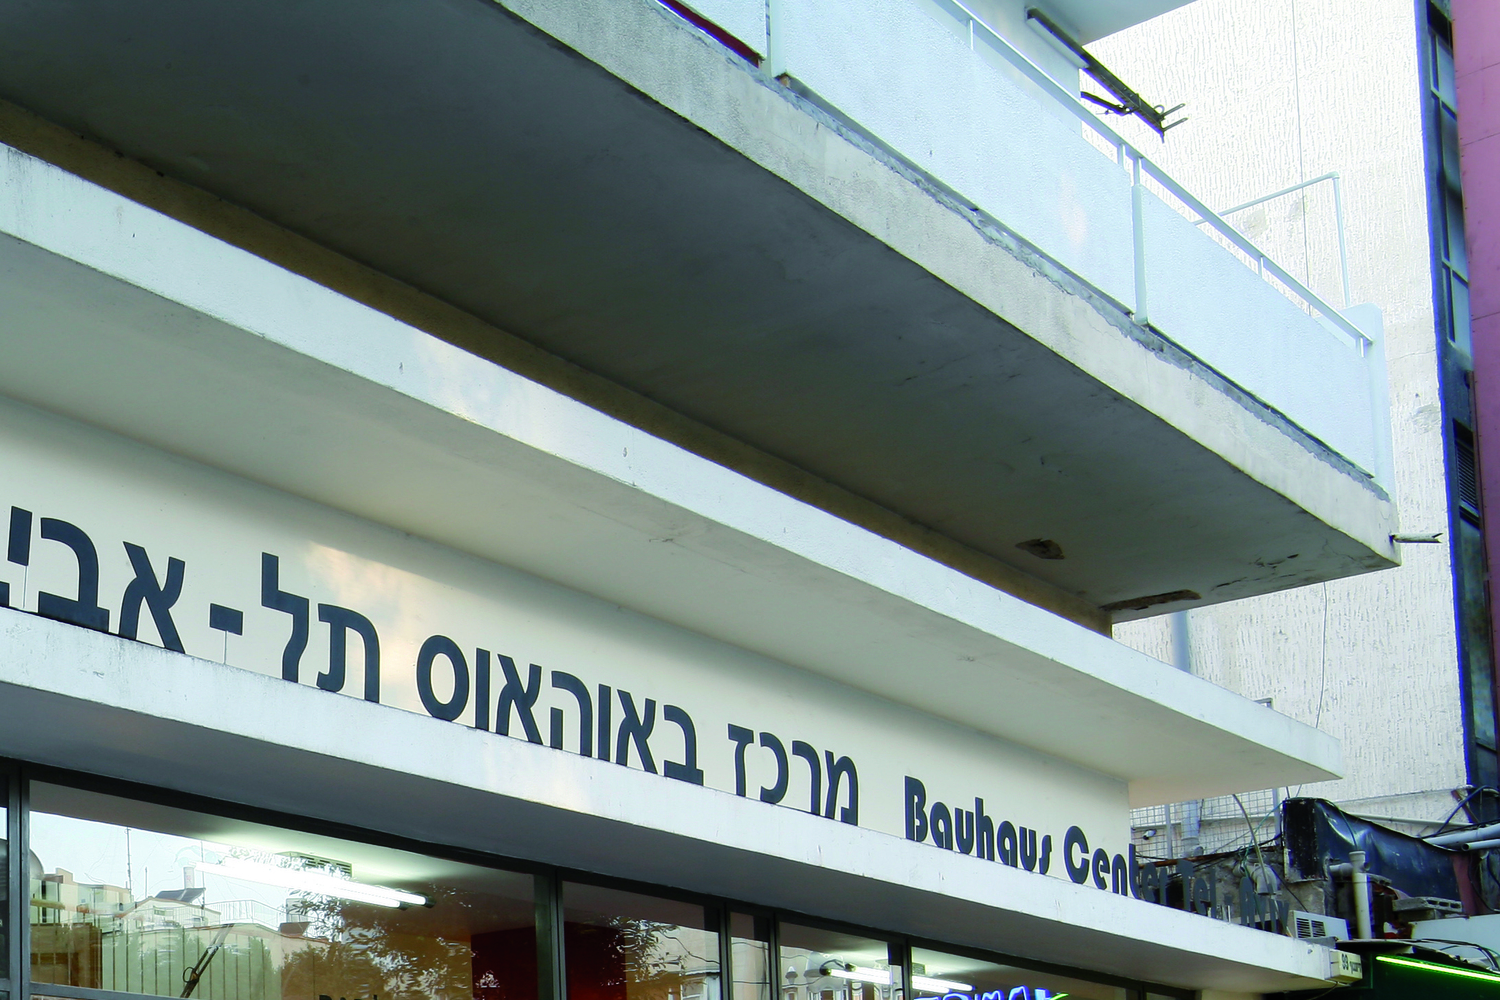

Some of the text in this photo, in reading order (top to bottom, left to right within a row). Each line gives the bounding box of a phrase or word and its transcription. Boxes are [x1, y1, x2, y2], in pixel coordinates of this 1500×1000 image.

[415, 634, 705, 786] באוהאוס
[727, 723, 860, 826] מרכז
[904, 775, 1054, 875] Bauhaus
[1063, 825, 1168, 906] Center
